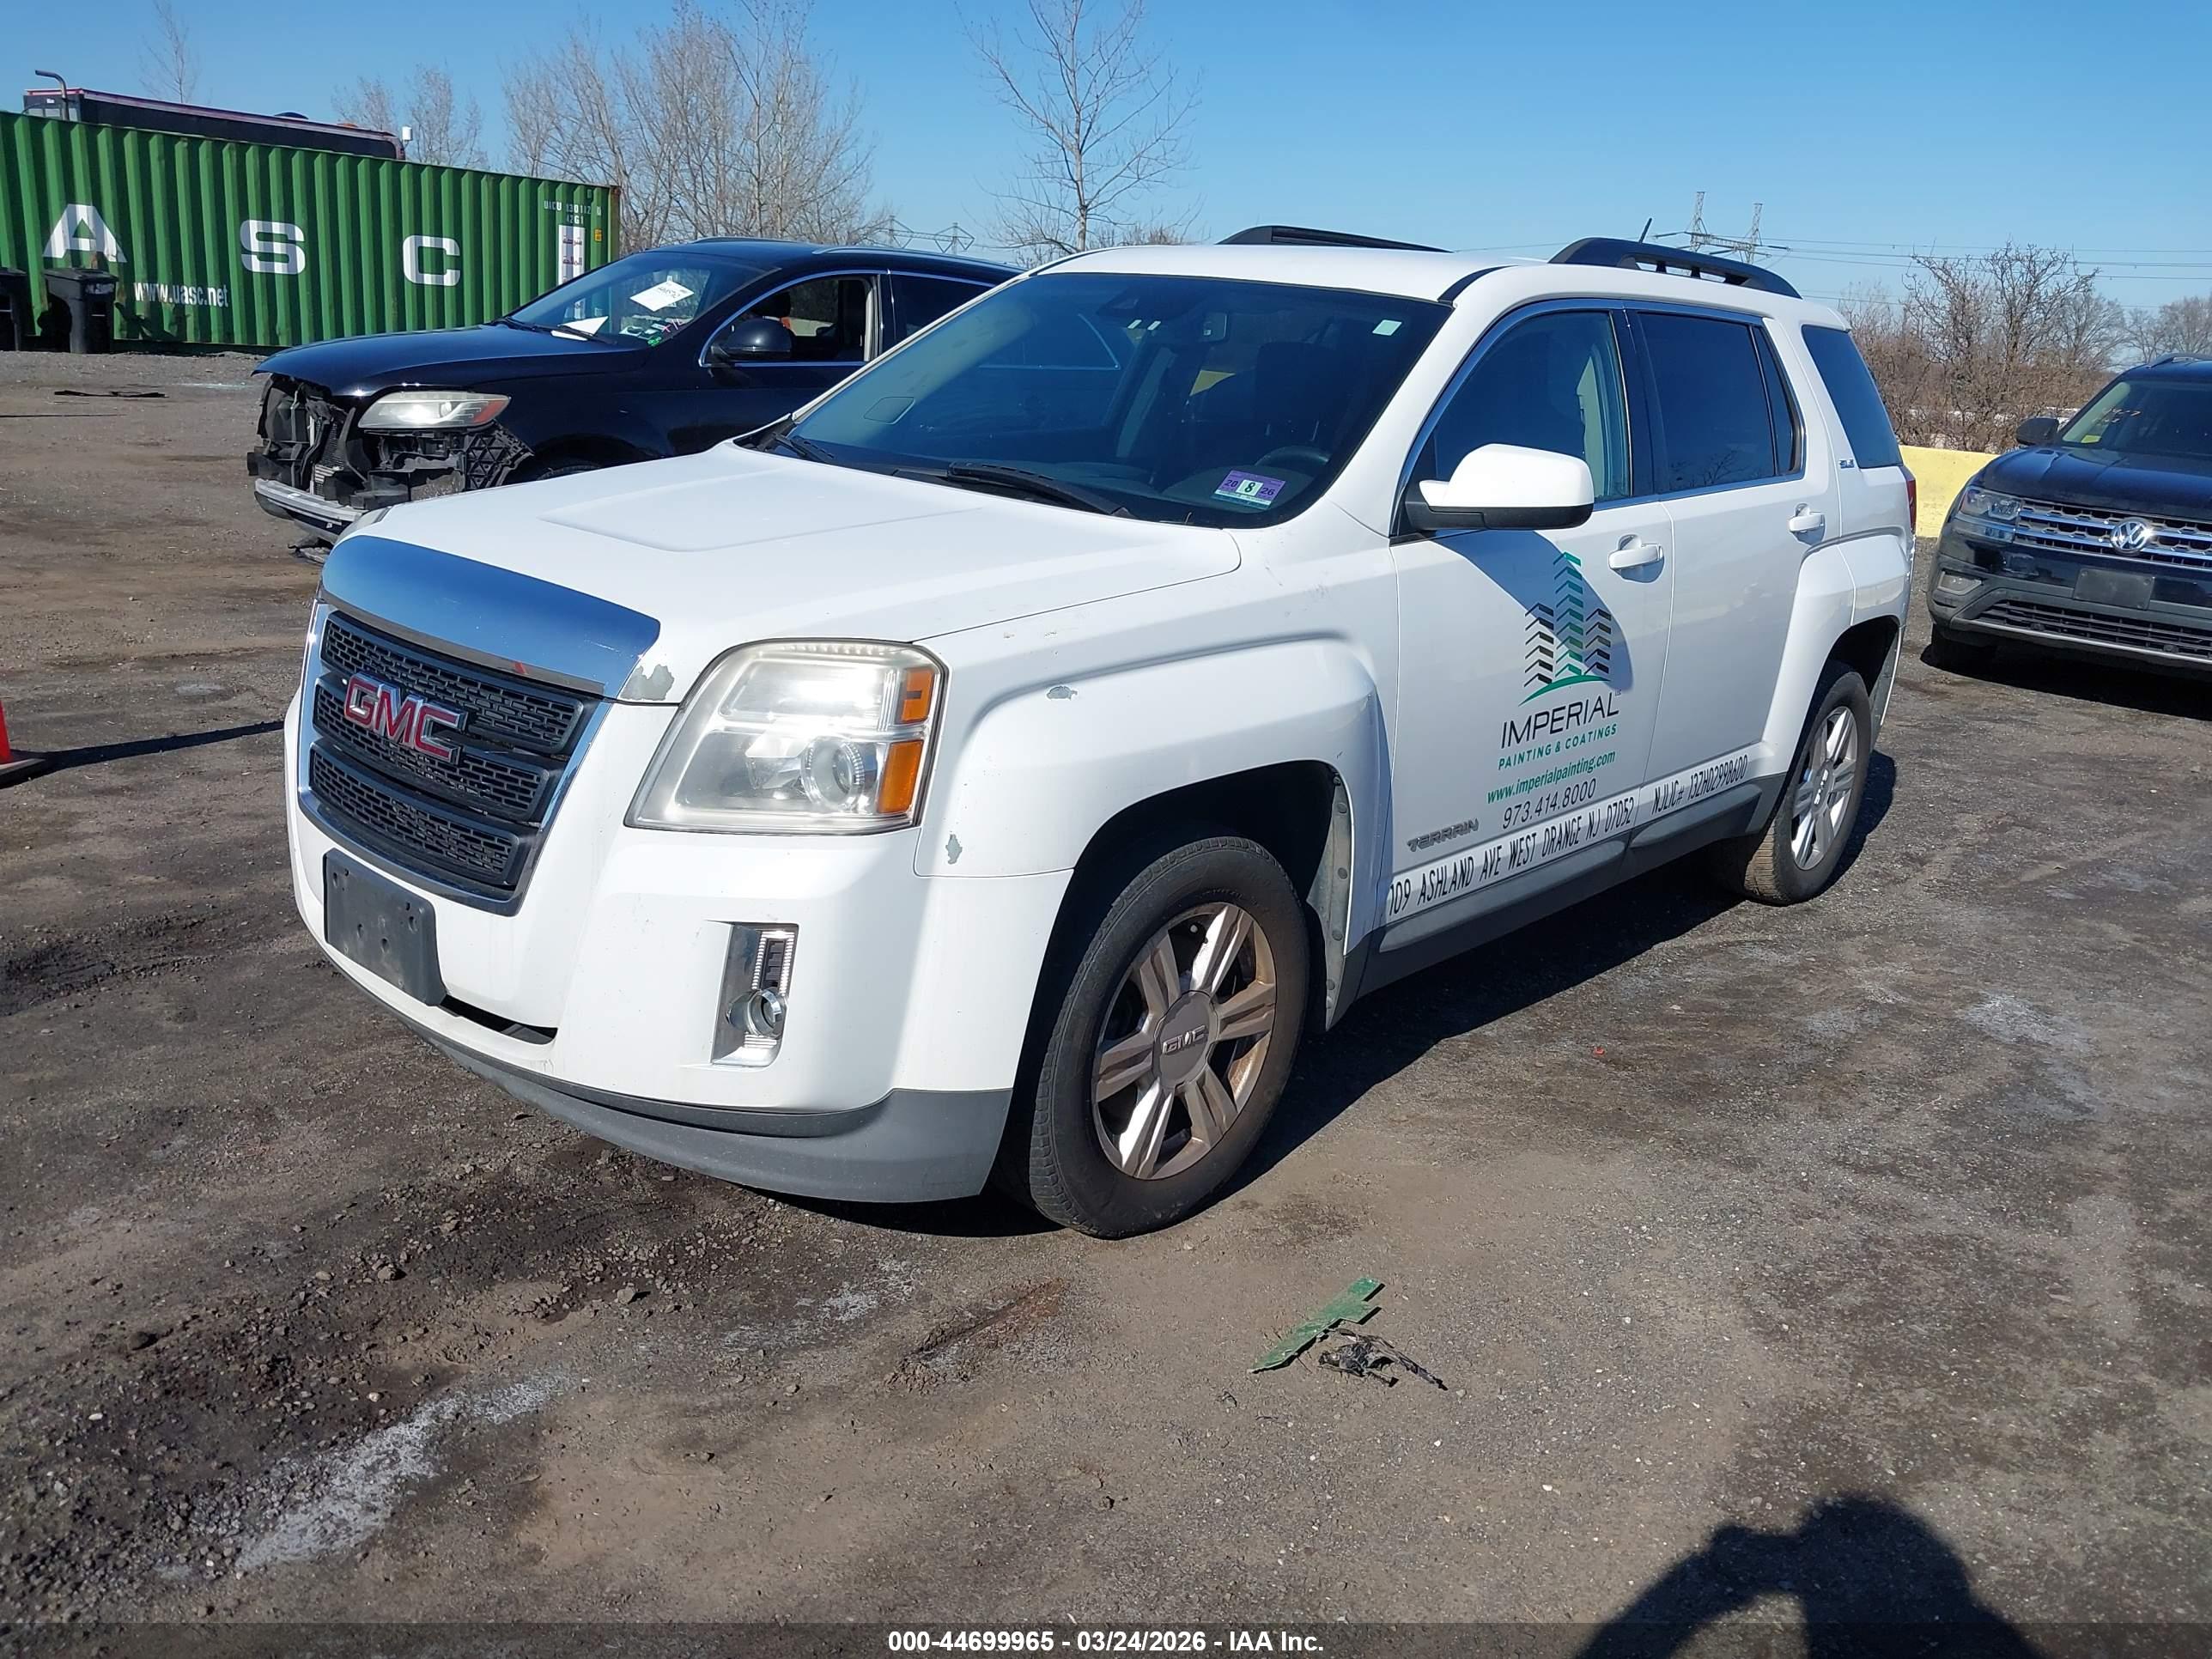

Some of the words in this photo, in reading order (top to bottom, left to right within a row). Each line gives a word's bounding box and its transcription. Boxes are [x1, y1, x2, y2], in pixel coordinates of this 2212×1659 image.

[42, 204, 128, 263] A
[240, 219, 306, 275] S
[402, 234, 461, 287] C
[133, 282, 229, 308] www.uasc.net
[1224, 479, 1239, 489] 20
[1244, 482, 1256, 493] 8
[1261, 487, 1275, 496] 26
[344, 672, 468, 765] GMC
[1501, 692, 1620, 749] IMPERIAL
[1498, 744, 1552, 770] PAINTING
[1554, 741, 1561, 753] &
[1565, 724, 1617, 750] COATINGS
[1486, 751, 1615, 804] www.imperialpainting.com
[1503, 778, 1596, 830] 973.414.8000
[1388, 878, 1412, 916] 109
[1417, 855, 1475, 906] ASHLAND
[1480, 844, 1503, 882] AVE
[1508, 832, 1538, 871] WEST
[1541, 815, 1583, 858] ORANGE
[1585, 808, 1601, 842] NJ
[1604, 796, 1635, 833] 07052
[1406, 817, 1480, 853] TERRAIN
[1162, 1024, 1206, 1054] GMC
